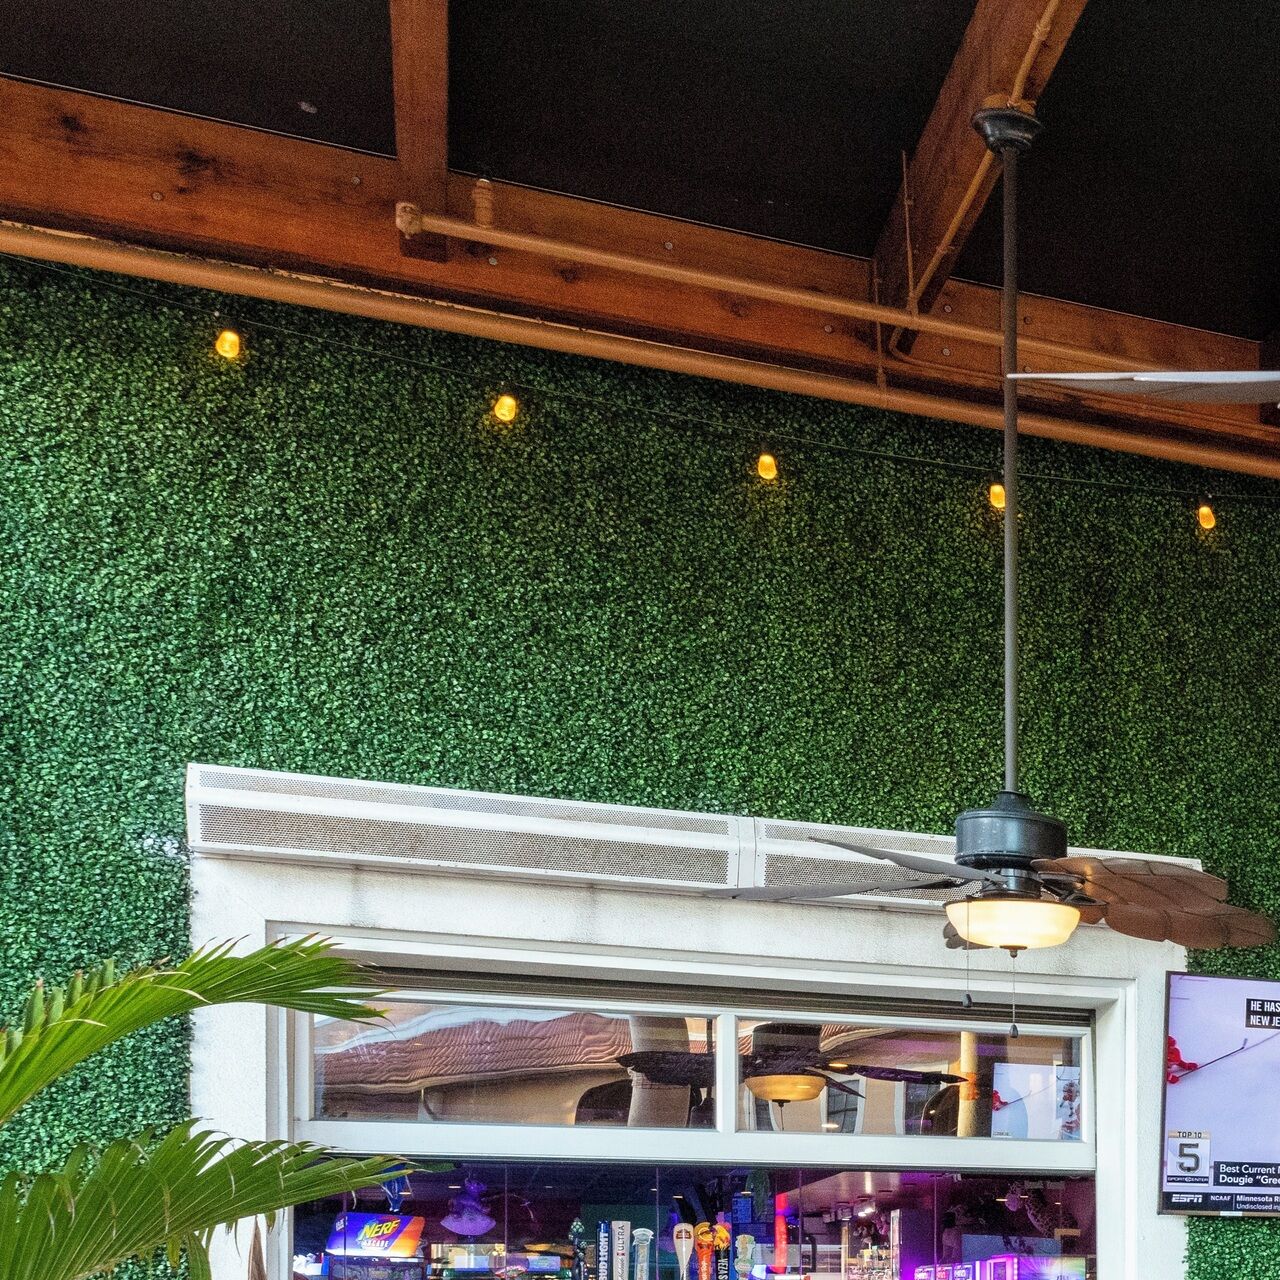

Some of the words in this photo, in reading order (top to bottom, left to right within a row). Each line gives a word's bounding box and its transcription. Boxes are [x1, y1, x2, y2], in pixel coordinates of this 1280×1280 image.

[1250, 1000, 1262, 1011] HE
[1264, 1002, 1280, 1012] HAS
[1250, 1015, 1270, 1026] NEW
[1178, 1143, 1200, 1173] 5
[1220, 1164, 1240, 1173] Best
[1242, 1165, 1275, 1175] Current
[1219, 1174, 1253, 1185] Dougie
[1172, 1194, 1203, 1203] ESPN
[361, 1220, 400, 1240] NERF
[599, 1232, 609, 1262] LIGHT
